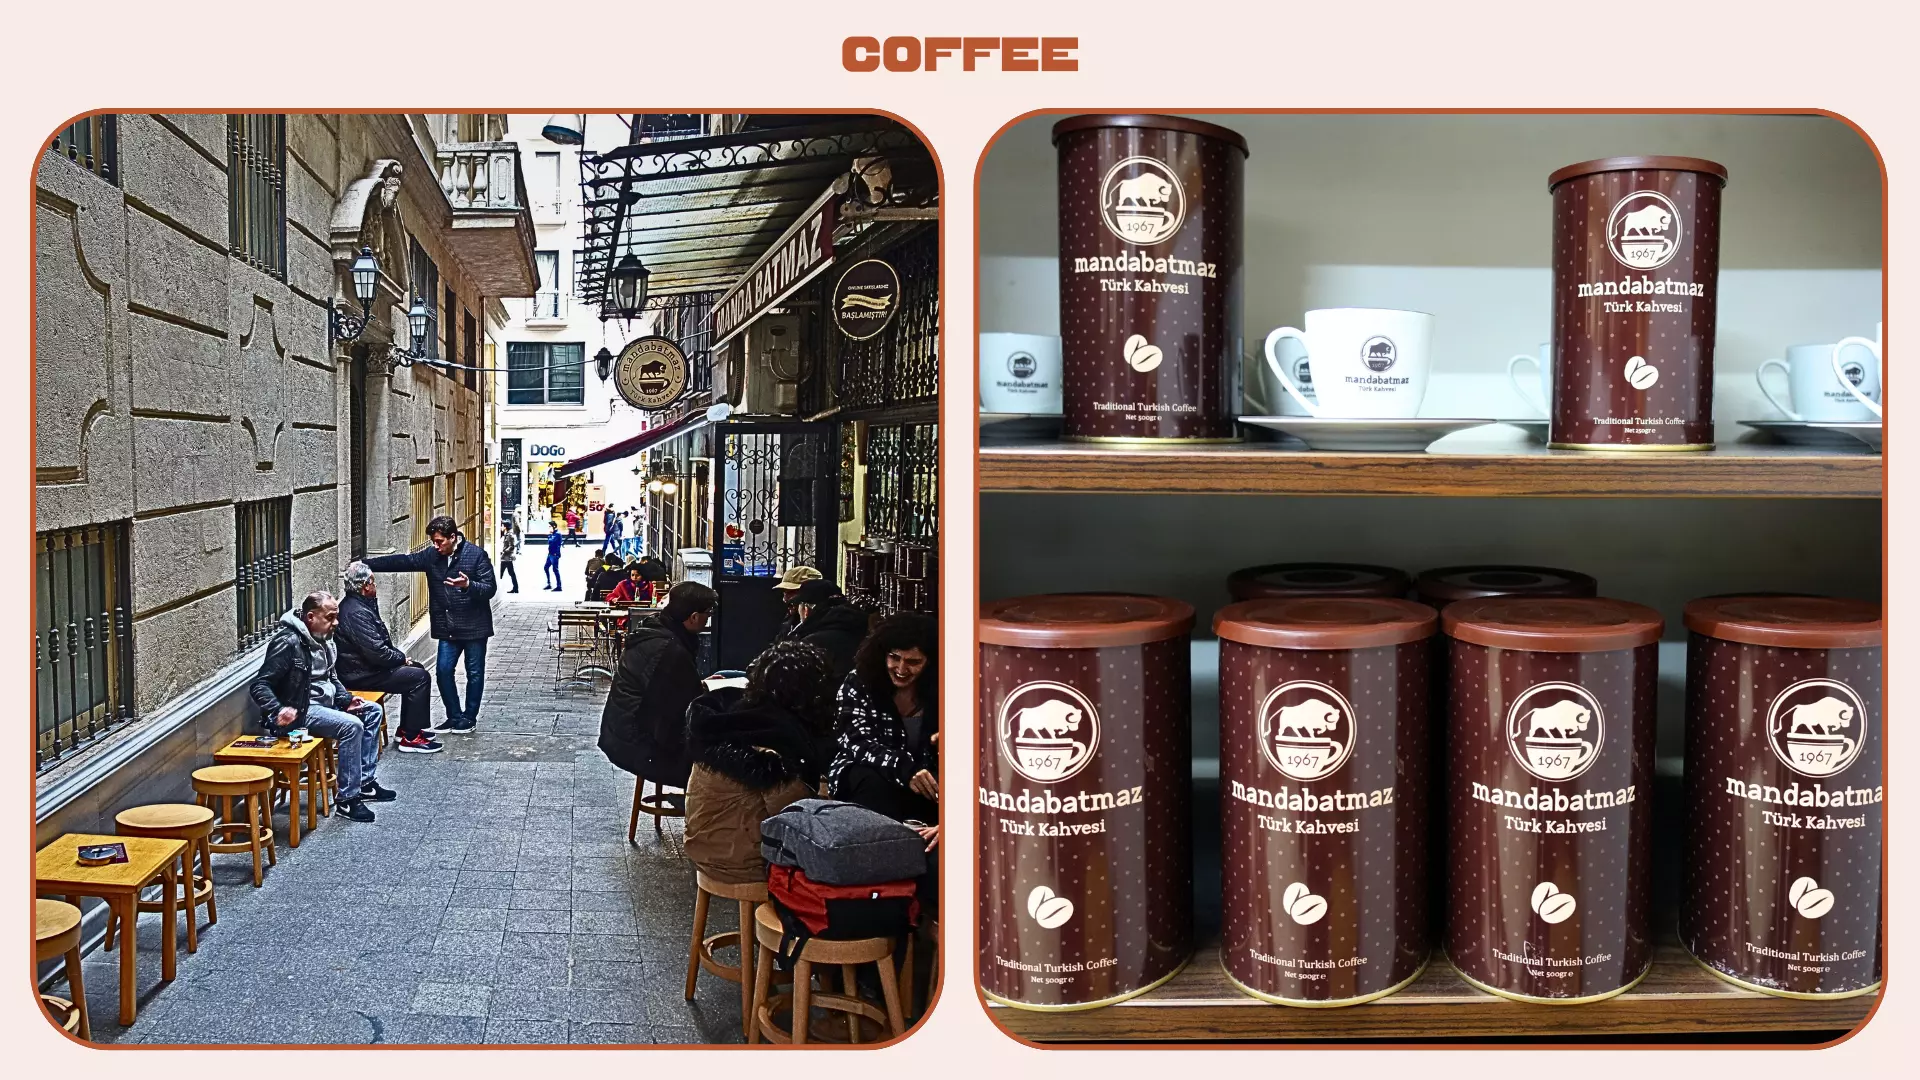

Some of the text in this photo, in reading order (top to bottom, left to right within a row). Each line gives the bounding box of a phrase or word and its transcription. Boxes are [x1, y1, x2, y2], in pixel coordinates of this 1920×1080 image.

[1126, 221, 1155, 234] 1967
[1631, 248, 1656, 260] 1967
[1074, 250, 1217, 279] mandabatmaz
[716, 211, 822, 340] MANDA BATMAZ
[1100, 278, 1190, 295] Türk Kahvesi
[1577, 275, 1704, 298] mandabatmaz
[1604, 300, 1682, 313] Türk Kahvesi
[623, 342, 681, 372] mandabatmaz
[1345, 375, 1409, 384] mandabatmaz
[630, 388, 676, 404] Türk Kahvesi
[1093, 402, 1196, 412] Traditional Turkish Coffee
[1593, 417, 1633, 425] Traditional
[1635, 417, 1664, 425] Turkish
[1028, 755, 1062, 770] 1967
[1287, 753, 1319, 768] 1967
[1538, 754, 1570, 768] 1967
[1800, 750, 1832, 765] 1967
[1232, 780, 1393, 812] mandabatmaz
[1472, 782, 1636, 812] mandabatmaz
[1000, 818, 1106, 837] Türk Kahvesi
[1258, 814, 1360, 834] Türk Kahvesi
[1504, 815, 1607, 834] Türk Kahvesi
[1762, 810, 1866, 830] Türk Kahvesi
[1250, 948, 1368, 968] Traditional Turkish Coffee
[1492, 948, 1612, 966] Traditional Turkish Coffee
[1746, 942, 1866, 962] Traditional Turkish Coffee
[996, 955, 1118, 972] Traditional Turkish Coffee
[1284, 970, 1297, 978] Net
